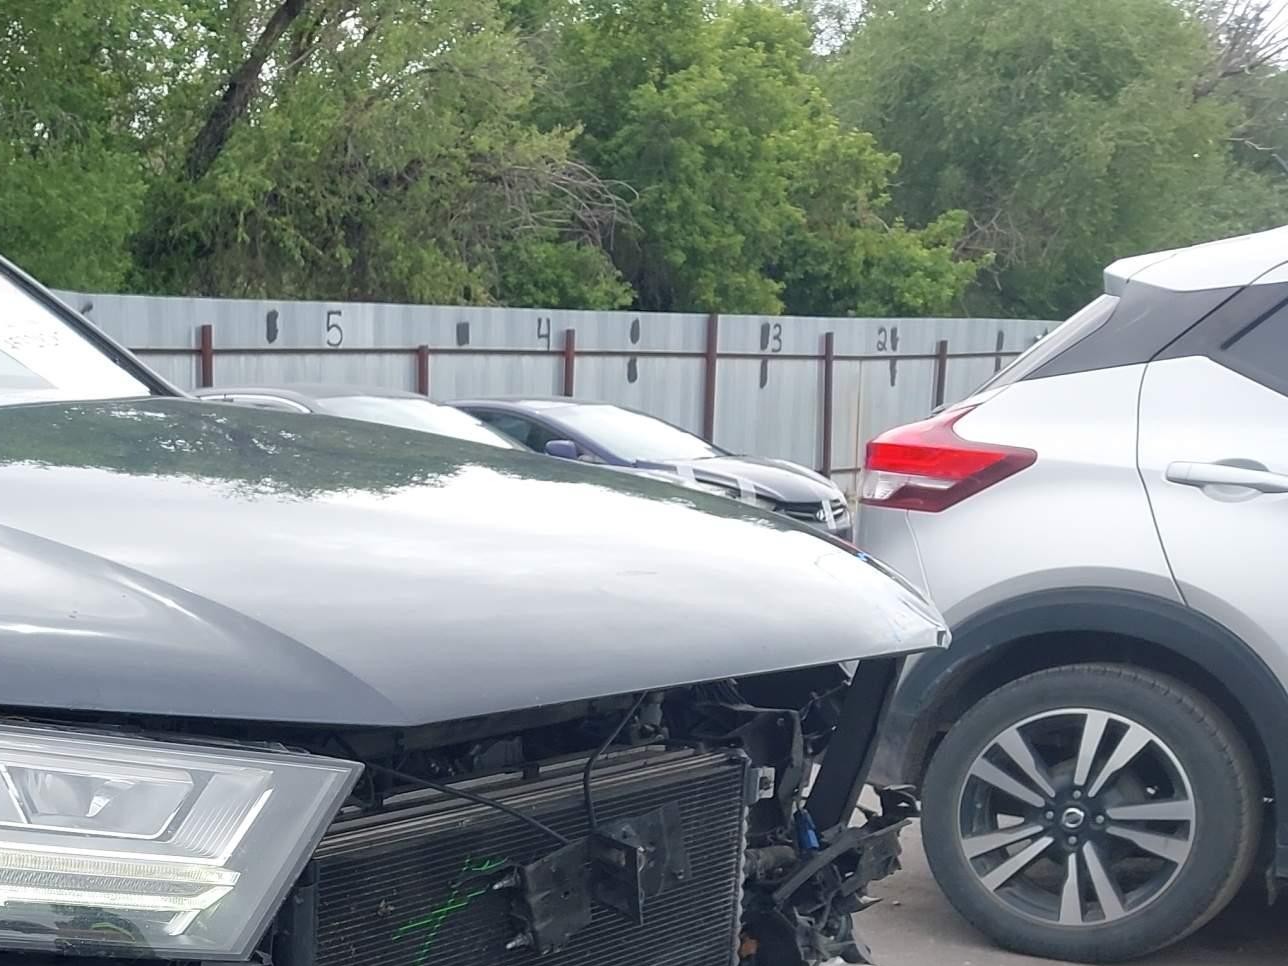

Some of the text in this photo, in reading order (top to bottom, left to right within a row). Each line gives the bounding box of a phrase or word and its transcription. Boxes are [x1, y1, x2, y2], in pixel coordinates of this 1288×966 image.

[326, 310, 344, 348] 5
[537, 317, 551, 351] 4
[771, 323, 783, 353] 3
[876, 327, 888, 351] 2
